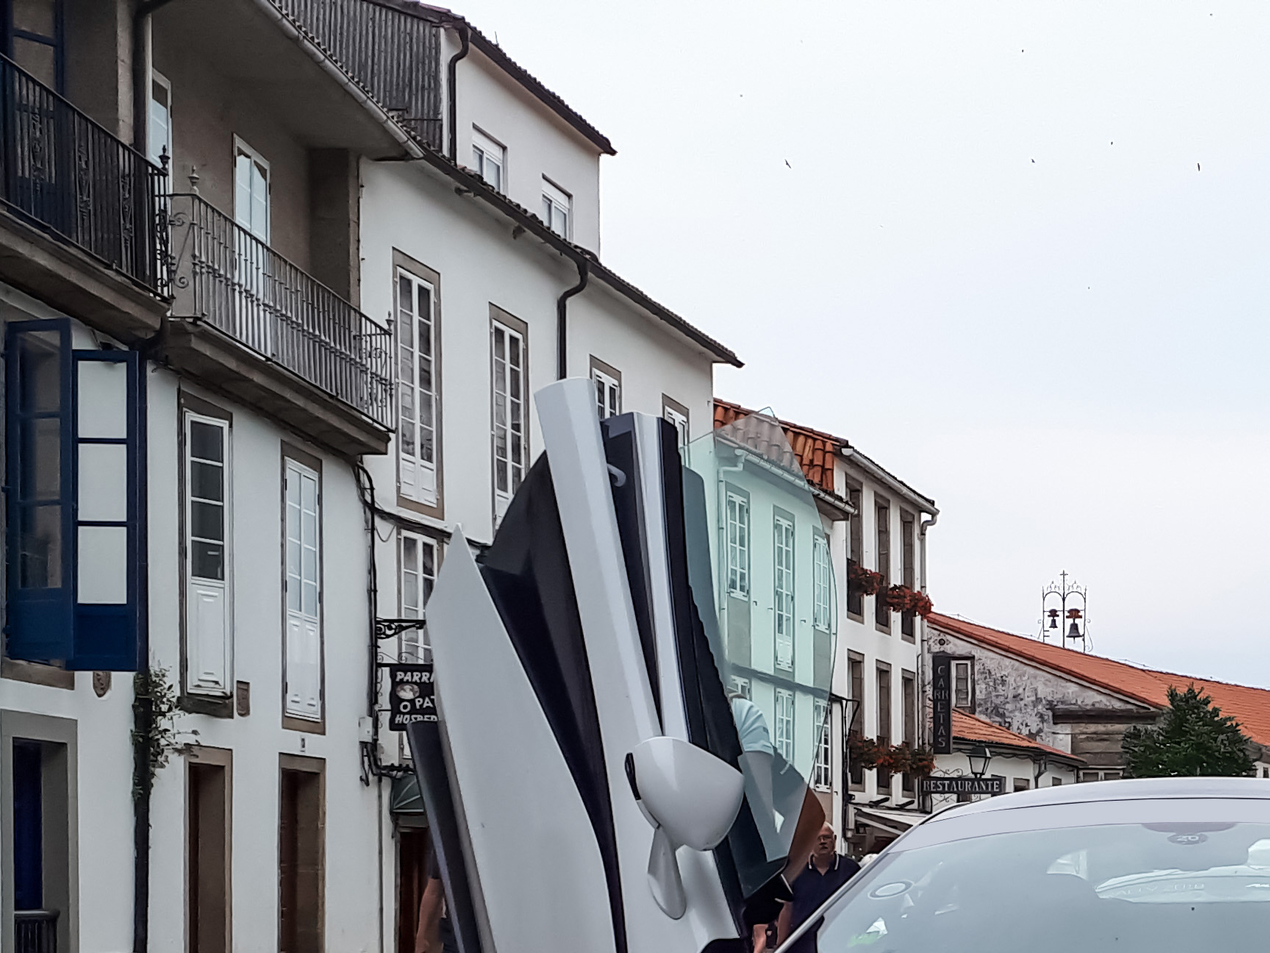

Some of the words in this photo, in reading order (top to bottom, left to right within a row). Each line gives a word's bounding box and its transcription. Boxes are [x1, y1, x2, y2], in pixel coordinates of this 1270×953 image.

[399, 701, 411, 712] O
[933, 665, 949, 747] CARRETAS
[923, 780, 1000, 792] RESTAURANTE
